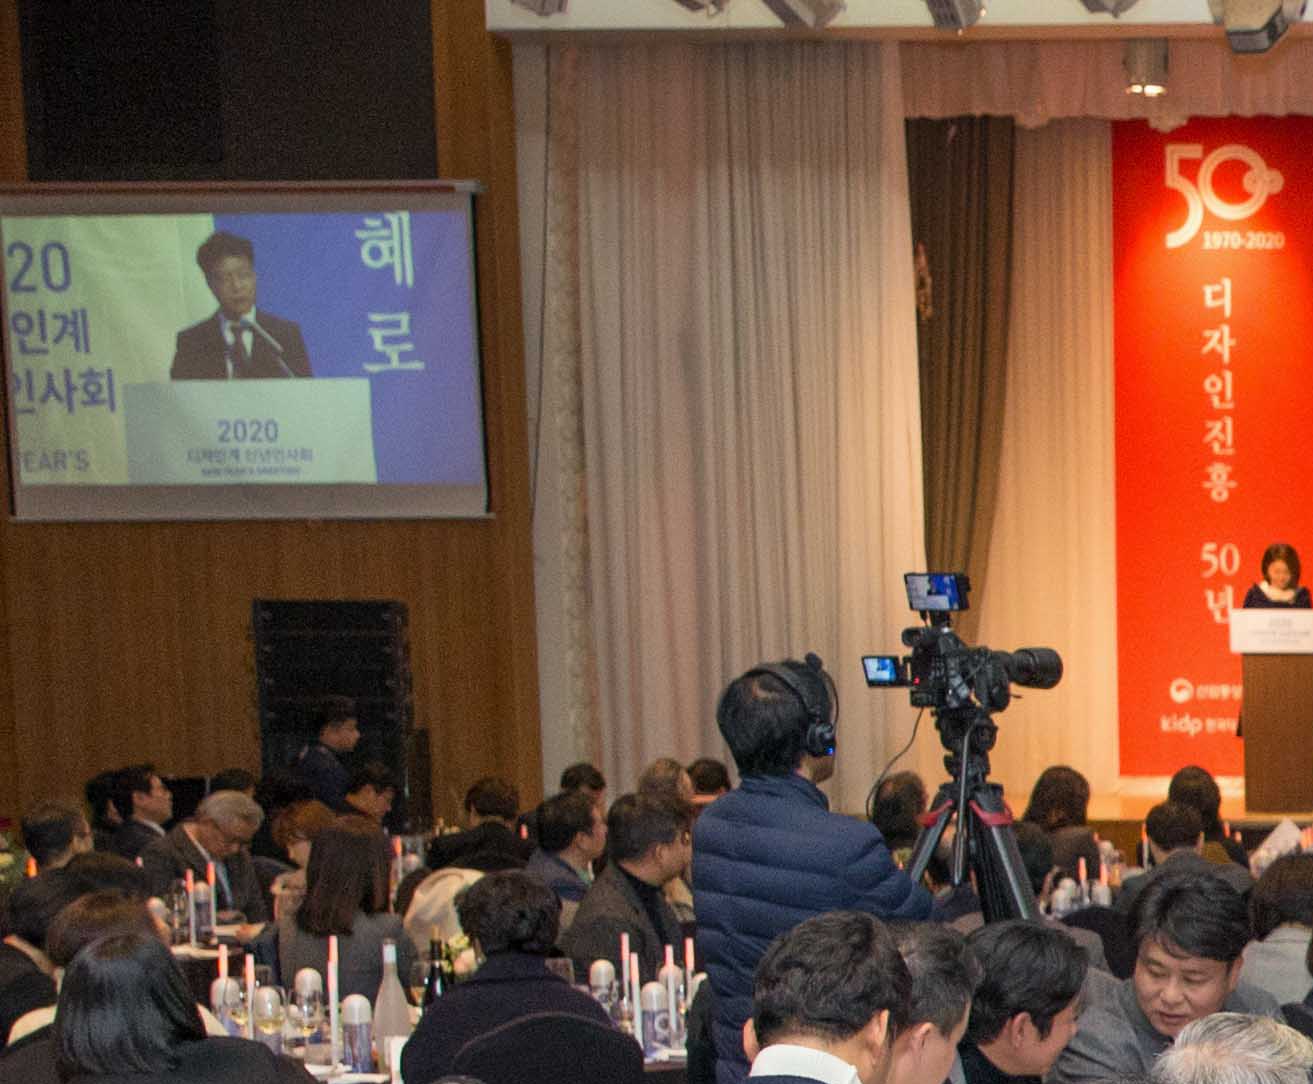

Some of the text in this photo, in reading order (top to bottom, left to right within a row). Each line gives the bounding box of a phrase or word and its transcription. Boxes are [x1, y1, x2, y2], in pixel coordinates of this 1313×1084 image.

[1165, 143, 1276, 249] 50
[1202, 231, 1286, 250] 1970-2020
[8, 241, 72, 293] 20
[12, 308, 91, 356] 인계
[217, 419, 279, 444] 2020
[21, 448, 90, 474] EAR'S
